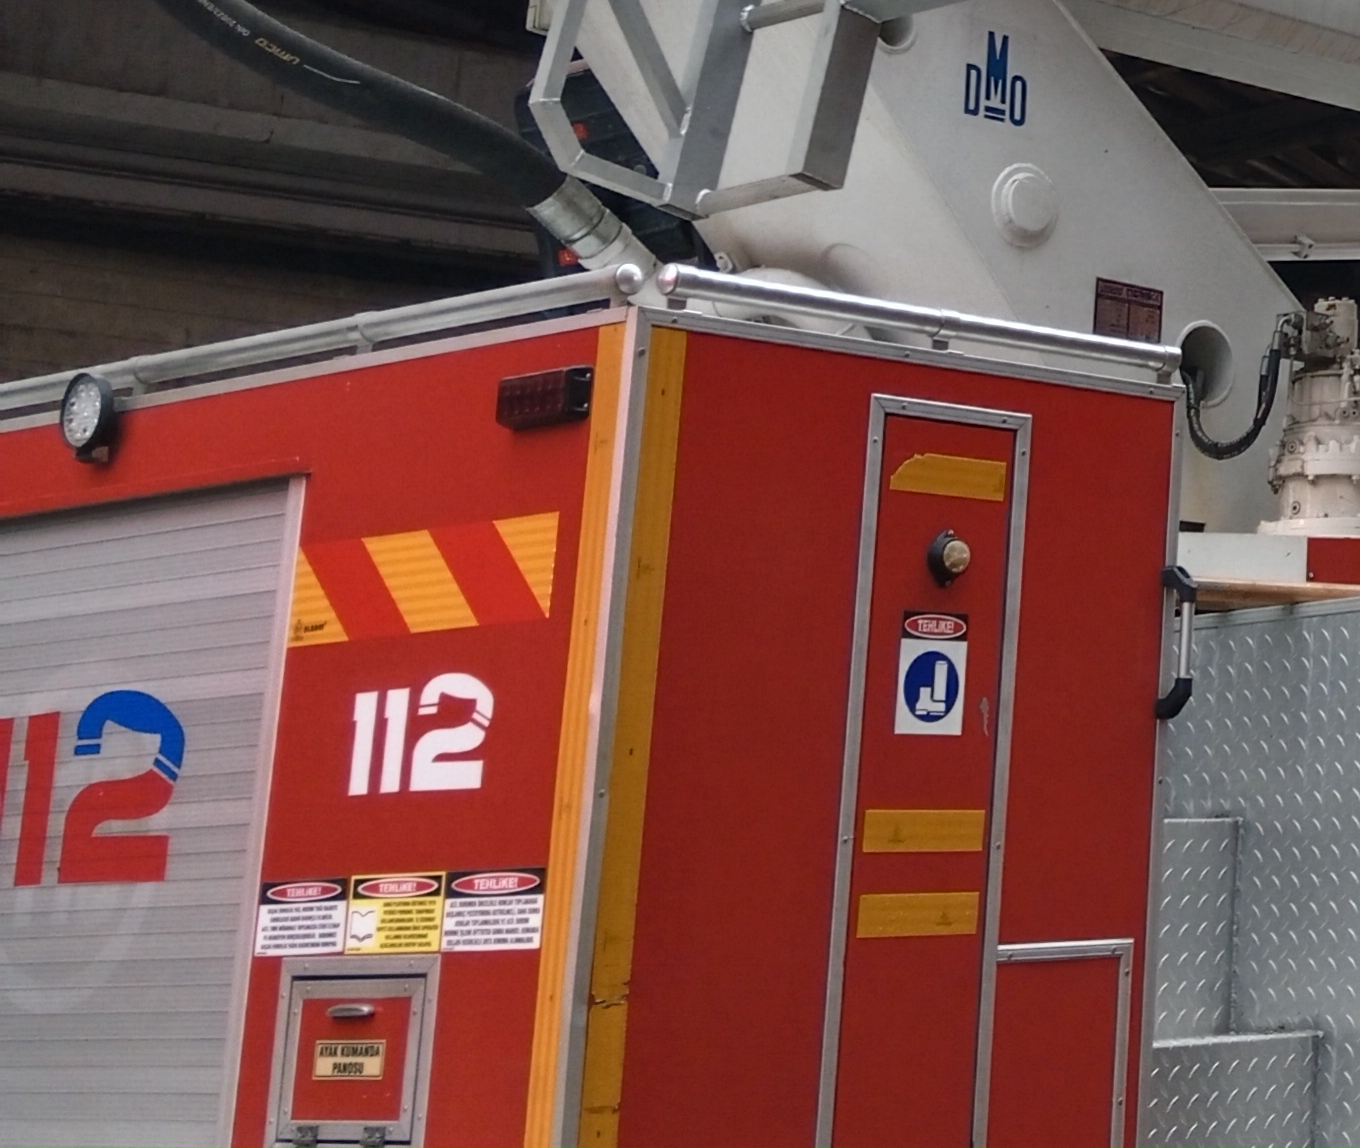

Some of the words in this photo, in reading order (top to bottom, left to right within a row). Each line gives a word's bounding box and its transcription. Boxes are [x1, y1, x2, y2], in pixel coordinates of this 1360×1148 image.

[348, 672, 495, 797] 112
[0, 690, 186, 887] 12
[331, 1062, 365, 1076] PANOSU
[340, 1044, 381, 1058] KUMANDA
